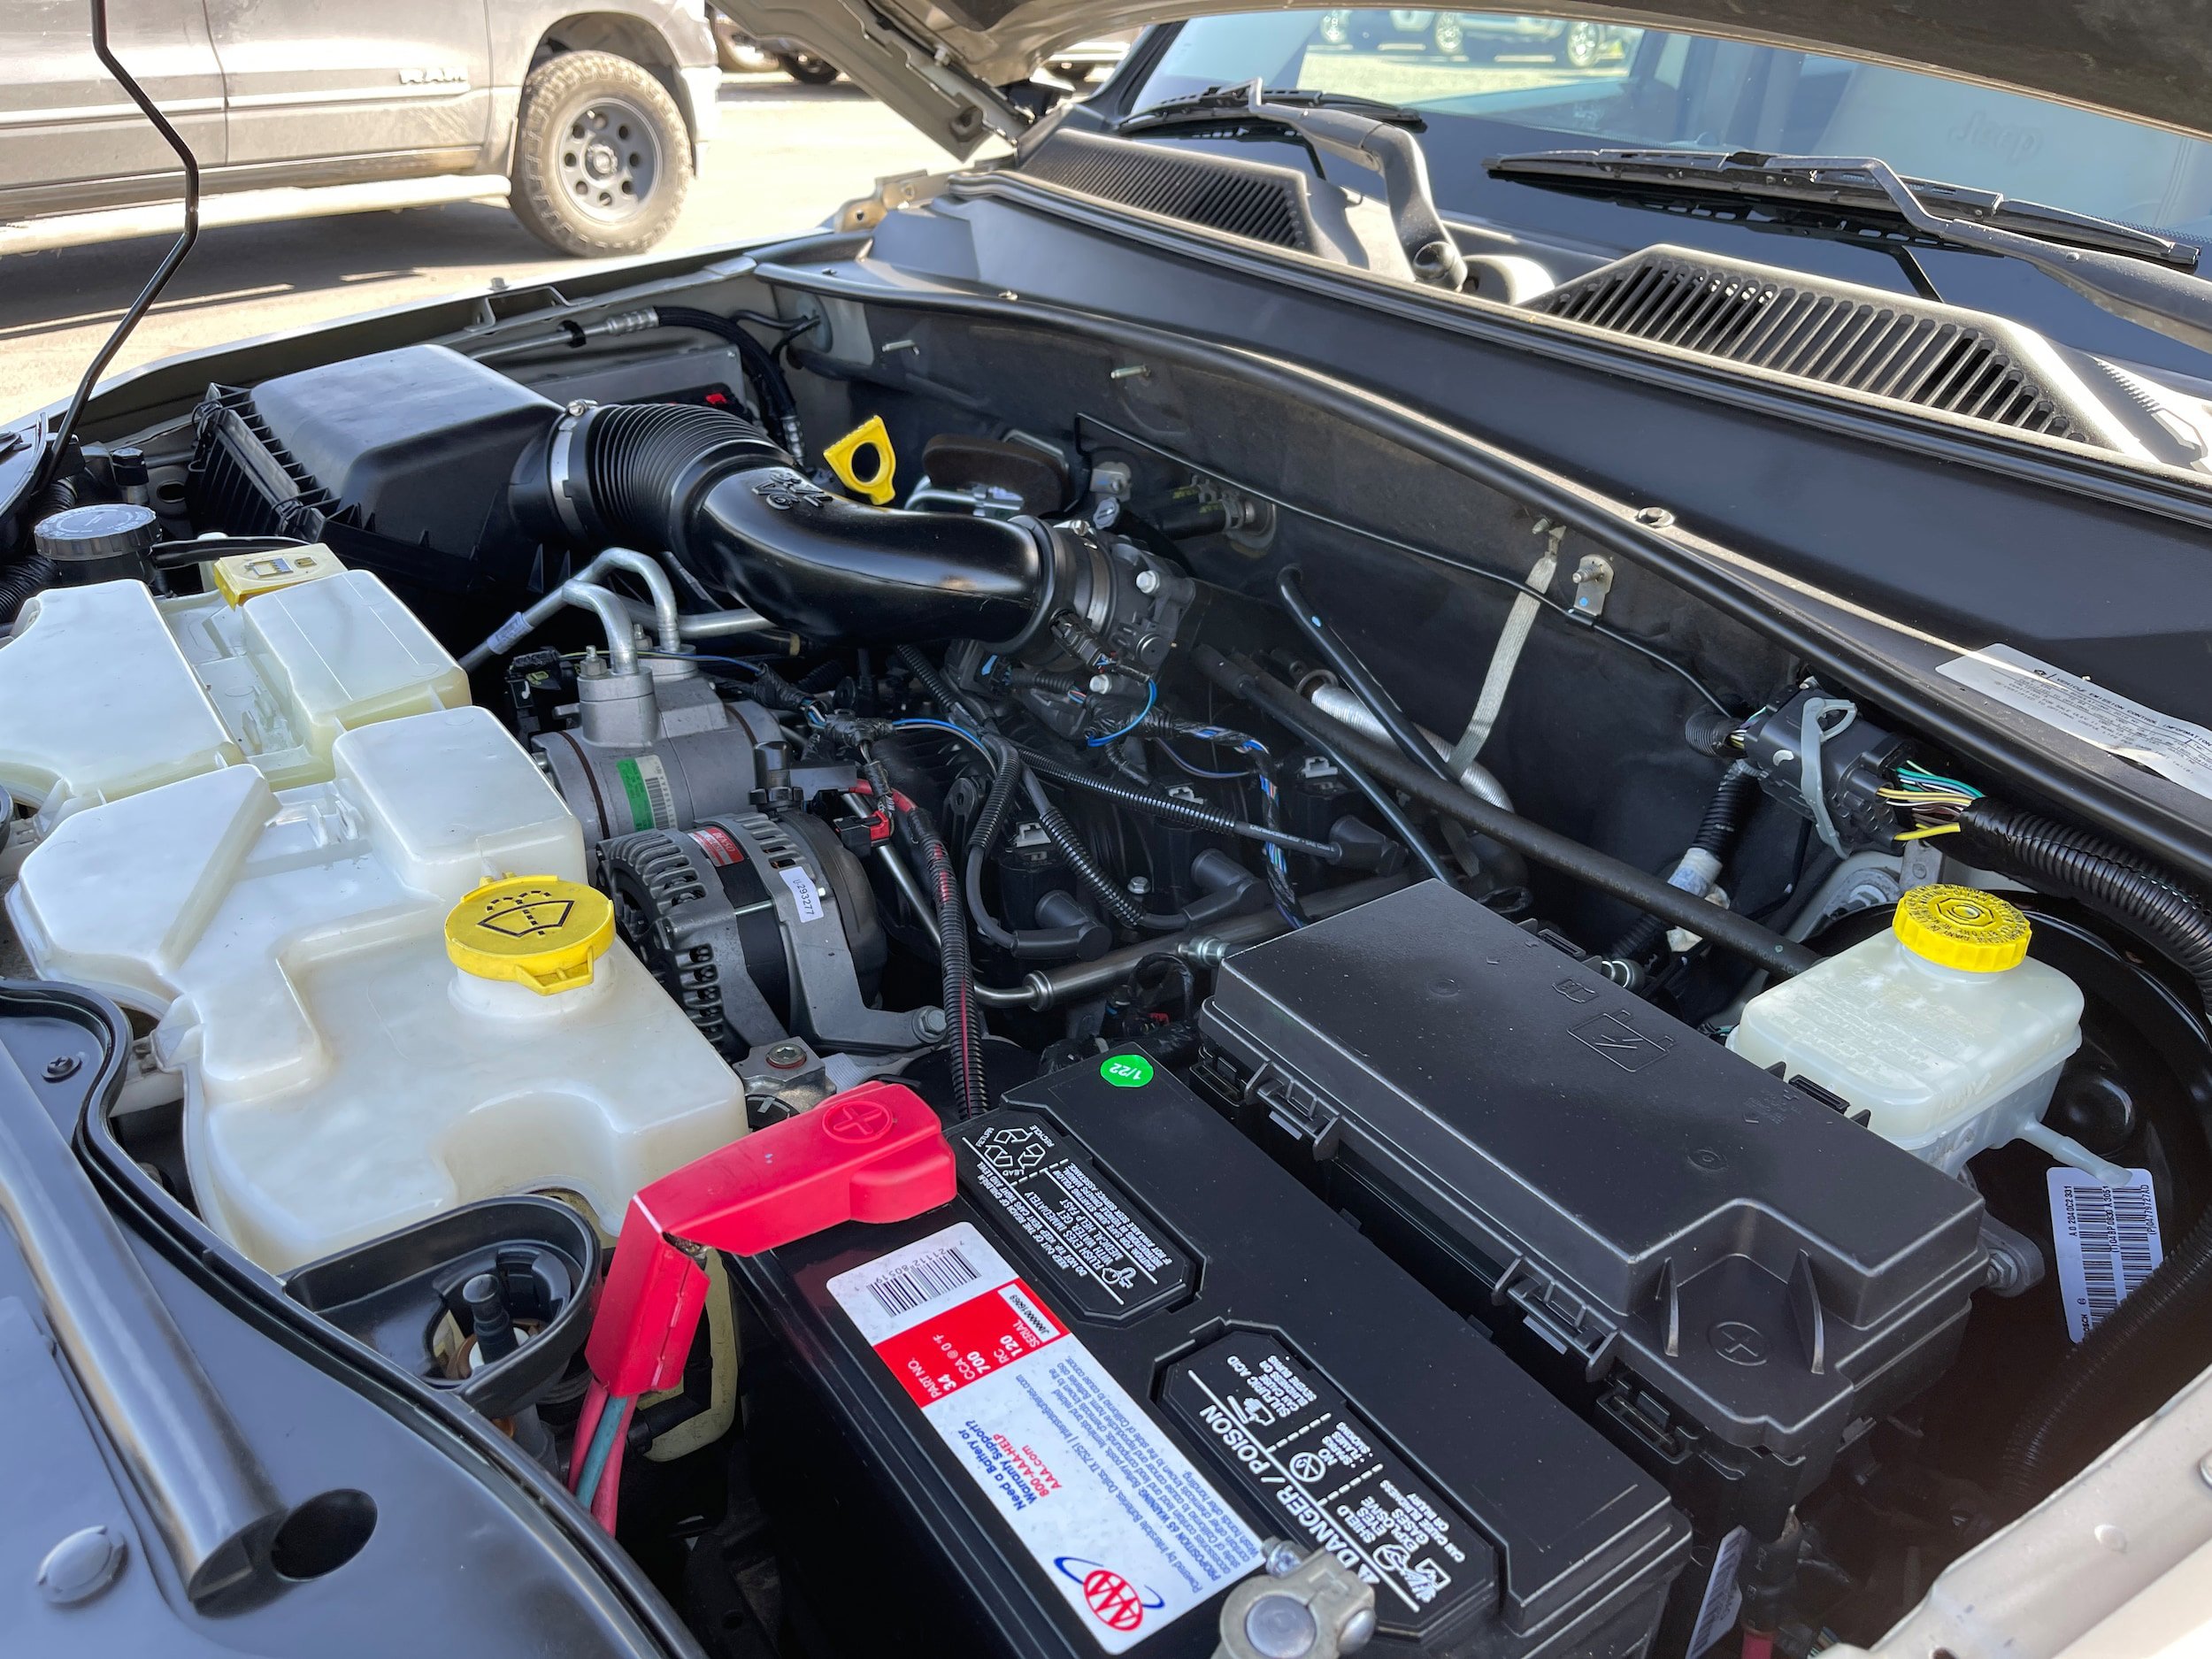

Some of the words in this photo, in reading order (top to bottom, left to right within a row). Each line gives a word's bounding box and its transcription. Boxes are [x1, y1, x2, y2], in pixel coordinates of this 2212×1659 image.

[399, 68, 467, 84] RAM
[751, 480, 802, 511] V6
[2089, 693, 2124, 710] EMISSION
[1110, 1063, 1141, 1080] 1/22
[1029, 1124, 1055, 1148] RECYCLE
[976, 1161, 993, 1177] LEVEL
[977, 1174, 1002, 1198] CHILDREN
[989, 1175, 1003, 1187] AND
[1052, 1170, 1074, 1189] FOLLOW
[999, 1187, 1017, 1202] TIGHT
[1071, 1187, 1096, 1212] STARTING
[1094, 1190, 1117, 1210] SERVICE
[1006, 1204, 1026, 1224] REACH
[1013, 1201, 1030, 1216] CAPS
[1024, 1191, 1066, 1231] IMMEDIATELY
[1056, 1210, 1073, 1224] GET
[1058, 1199, 1079, 1216] FAST
[1093, 1210, 1110, 1225] JUMP
[1099, 1206, 1121, 1226] VEHICLE
[1113, 1209, 1130, 1224] SEEK
[1022, 1221, 1036, 1234] THE
[1025, 1215, 1042, 1230] VENT
[1075, 1215, 1096, 1233] HELP
[1106, 1224, 1122, 1238] SAFE
[1118, 1225, 1129, 1233] IN
[1032, 1233, 1044, 1242] OF
[1039, 1229, 1056, 1243] KEEP
[1063, 1230, 1083, 1248] EYES
[1071, 1223, 1096, 1248] WATER.
[1118, 1236, 1133, 1249] FOR
[1125, 1221, 1155, 1247] AVAILABLE
[1040, 1241, 1055, 1255] OUT
[1092, 1246, 1113, 1265] WITH
[1093, 1231, 1123, 1260] MEDICAL
[1125, 1231, 1163, 1267] INSTRUCTIONS
[1150, 1246, 1166, 1259] NOT
[1051, 1254, 1069, 1269] KEEP
[1063, 1254, 1079, 1267] NOT
[1078, 1247, 1104, 1270] FLUSH
[1074, 1265, 1087, 1276] DO
[1013, 1319, 1040, 1347] SERIAL
[2080, 1314, 2089, 1332] OSCH
[1000, 1334, 1022, 1356] 120
[966, 1351, 990, 1373] 700
[993, 1348, 1009, 1363] RC
[908, 1358, 925, 1376] NO.
[955, 1357, 975, 1379] CCA
[1048, 1368, 1060, 1379] the
[1056, 1362, 1070, 1375] also
[1226, 1356, 1251, 1377] ACID
[1258, 1360, 1273, 1373] OR
[1267, 1355, 1292, 1378] BURNS
[918, 1375, 941, 1398] PART
[937, 1373, 956, 1390] 34
[1056, 1378, 1065, 1386] to
[1067, 1374, 1091, 1400] Batteries
[1258, 1373, 1286, 1396] CAUSE
[1269, 1371, 1308, 1406] BLINDNESS
[1288, 1376, 1317, 1401] SEVERE
[1050, 1388, 1072, 1409] related
[1062, 1384, 1081, 1404] known
[1247, 1376, 1290, 1417] SULFURIC
[1280, 1394, 1299, 1411] CAN
[1016, 1374, 1071, 1439] InterstateBatteries.com
[1068, 1408, 1083, 1422] and
[1079, 1402, 1107, 1432] chemicals
[957, 1429, 970, 1439] or
[965, 1420, 1002, 1460] Support?
[1080, 1419, 1106, 1448] terminals
[1103, 1415, 1137, 1450] reproductive
[1200, 1405, 1269, 1473] POISON
[1336, 1422, 1370, 1454] SMOKING
[1071, 1442, 1093, 1463] 75251
[1320, 1435, 1352, 1464] SPARKS
[1331, 1431, 1361, 1459] FLAMES
[967, 1440, 996, 1473] Battery
[993, 1433, 1048, 1496] 800-AAA-HELP
[1132, 1449, 1148, 1463] and
[1317, 1448, 1337, 1465] NO
[994, 1472, 1003, 1481] a
[1022, 1445, 1061, 1488] AAA.com
[1087, 1461, 1100, 1472] TX
[1118, 1464, 1141, 1488] Battery
[1133, 1467, 1150, 1484] lead
[1145, 1463, 1166, 1485] cancer
[1000, 1460, 1036, 1503] Warranty
[1146, 1481, 1162, 1495] and
[999, 1482, 1025, 1509] Need
[1157, 1494, 1175, 1511] lead
[1164, 1484, 1184, 1503] cause
[1379, 1479, 1423, 1520] BLINDNESS
[1115, 1490, 1142, 1522] Batteries,
[1181, 1502, 1190, 1512] to
[1407, 1492, 1436, 1519] INJURY
[1166, 1521, 1179, 1532] 65
[1172, 1509, 1196, 1534] contain
[1187, 1510, 1217, 1543] California
[1277, 1486, 1358, 1567] DANGER
[1337, 1504, 1375, 1542] SHIELD
[1355, 1507, 1386, 1536] EYES
[1361, 1496, 1418, 1552] EXPLOSIVE
[1391, 1508, 1428, 1544] GASES
[1417, 1518, 1449, 1545] CAUSE
[1432, 1517, 1448, 1531] OR
[1140, 1520, 1168, 1553] Interstate
[1213, 1541, 1225, 1550] of
[1165, 1551, 1177, 1563] by
[1175, 1532, 1220, 1580] PROPOSITION
[1194, 1533, 1231, 1574] accessories
[1222, 1550, 1240, 1568] state
[1444, 1542, 1466, 1562] CAN
[1171, 1561, 1202, 1593] Powered
[1084, 1570, 1141, 1631] AAA
